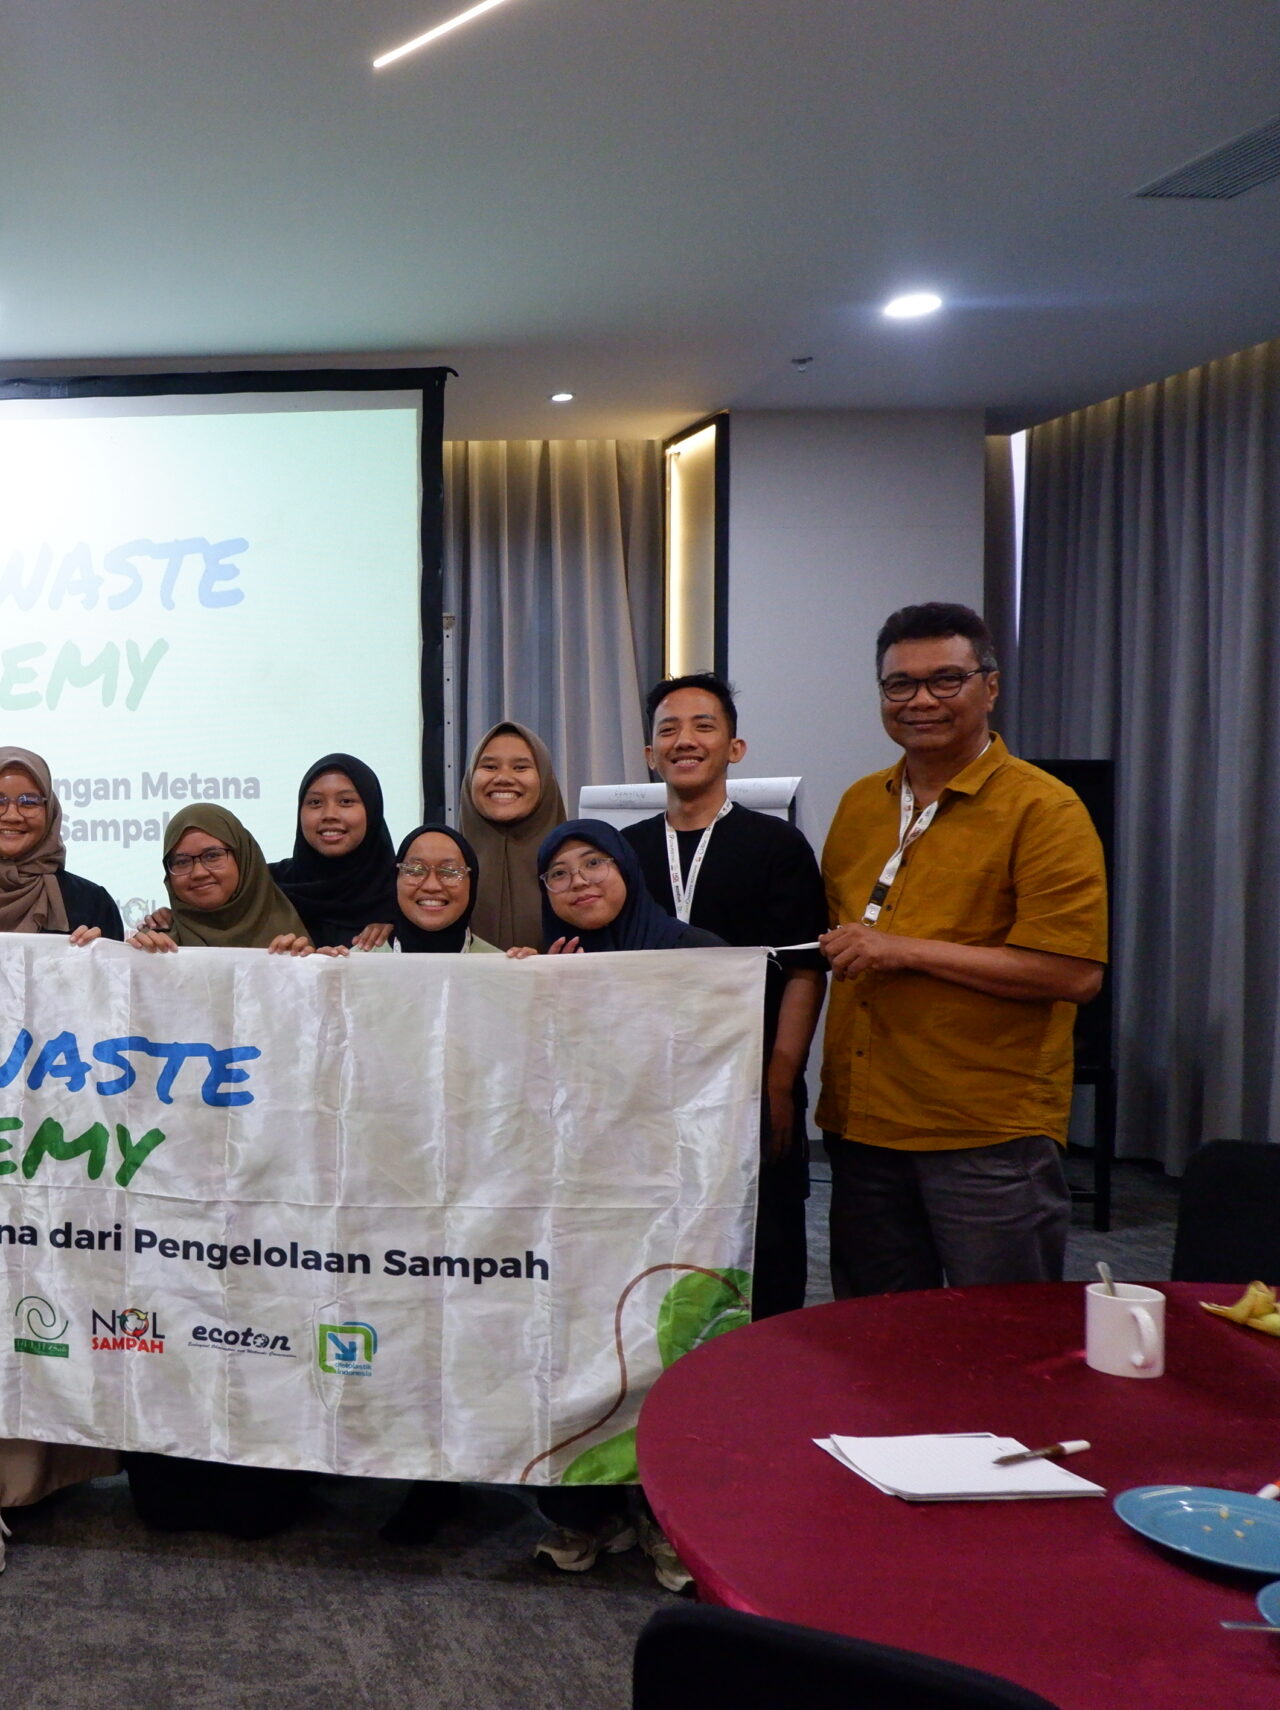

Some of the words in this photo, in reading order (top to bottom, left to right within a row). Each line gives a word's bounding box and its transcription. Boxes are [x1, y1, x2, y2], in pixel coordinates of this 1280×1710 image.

[141, 771, 261, 801] Metana
[49, 1222, 122, 1252] dari
[134, 1228, 371, 1275] Pengelolaan
[383, 1249, 550, 1286] Sampah
[91, 1336, 165, 1354] SAMPAH
[192, 1325, 291, 1351] ecoton
